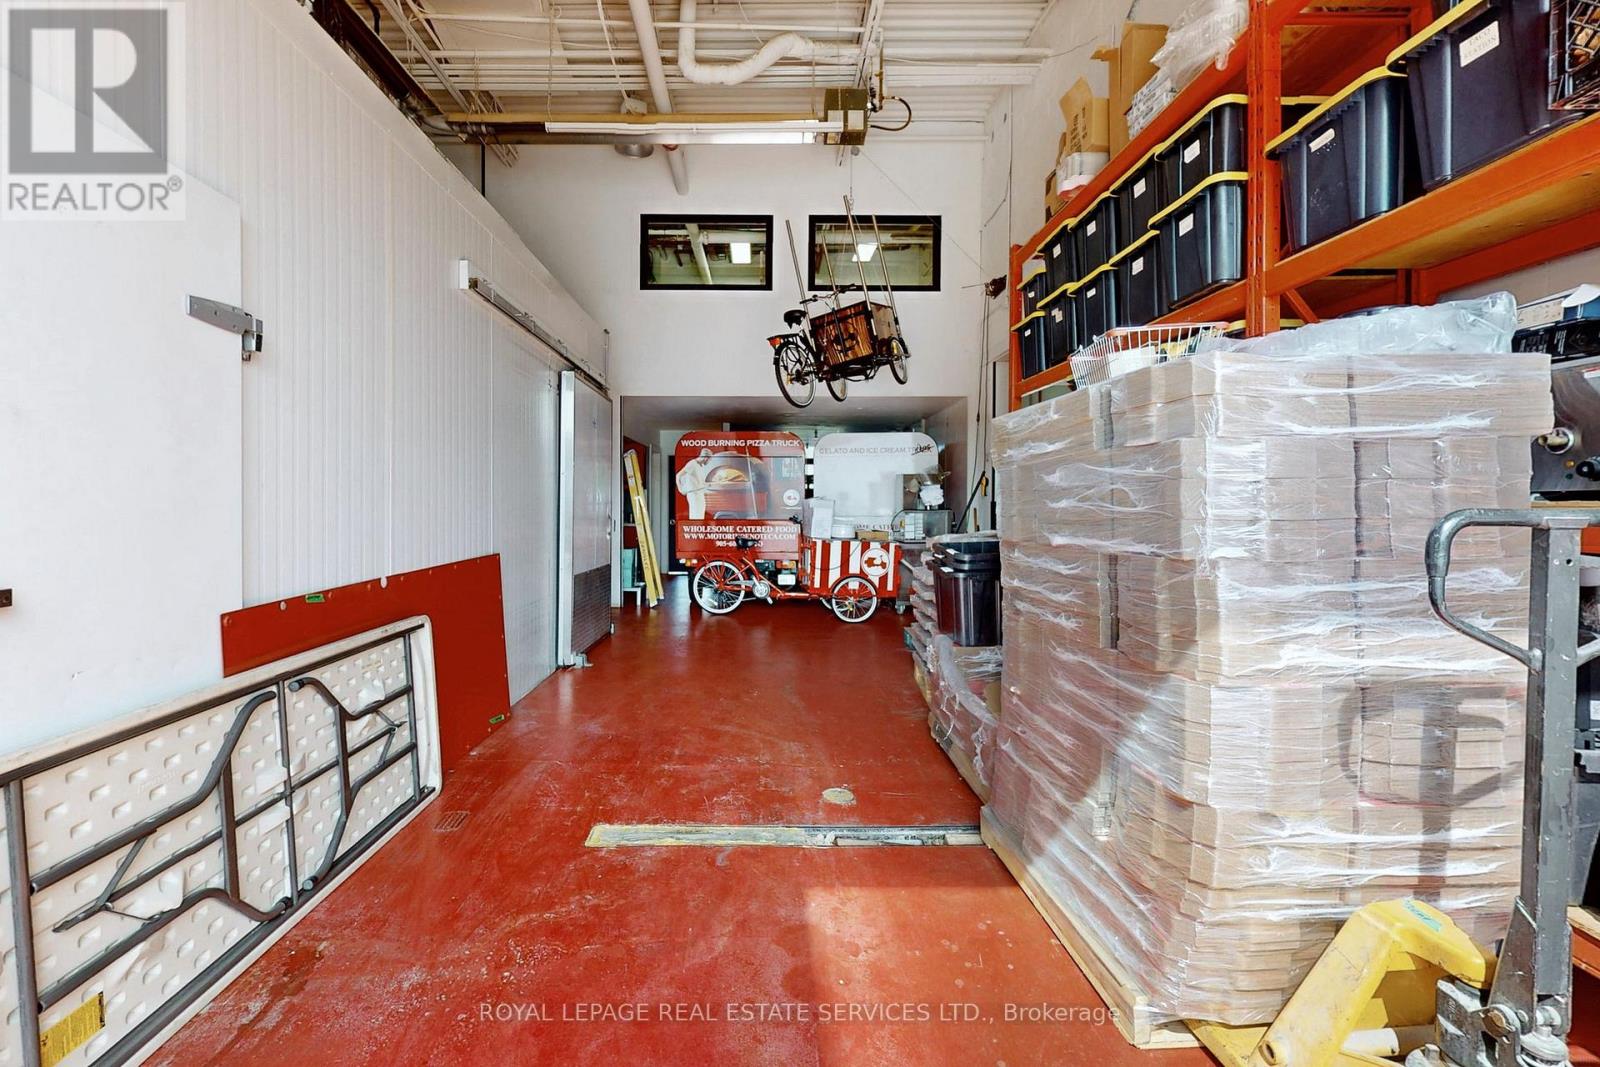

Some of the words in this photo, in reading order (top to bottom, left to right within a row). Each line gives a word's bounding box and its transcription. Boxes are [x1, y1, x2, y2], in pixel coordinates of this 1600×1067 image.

[681, 439, 707, 447] WOOD
[708, 439, 746, 447] BURNING
[747, 439, 770, 447] PIZZA
[772, 439, 800, 447] TRUCK
[820, 447, 848, 455] GELATO
[849, 447, 866, 455] AND
[867, 447, 879, 455] ICE
[879, 447, 907, 455] CREAM
[683, 525, 735, 533] WHOLESOME
[736, 525, 774, 533] CATERED
[775, 525, 798, 533] FOOD
